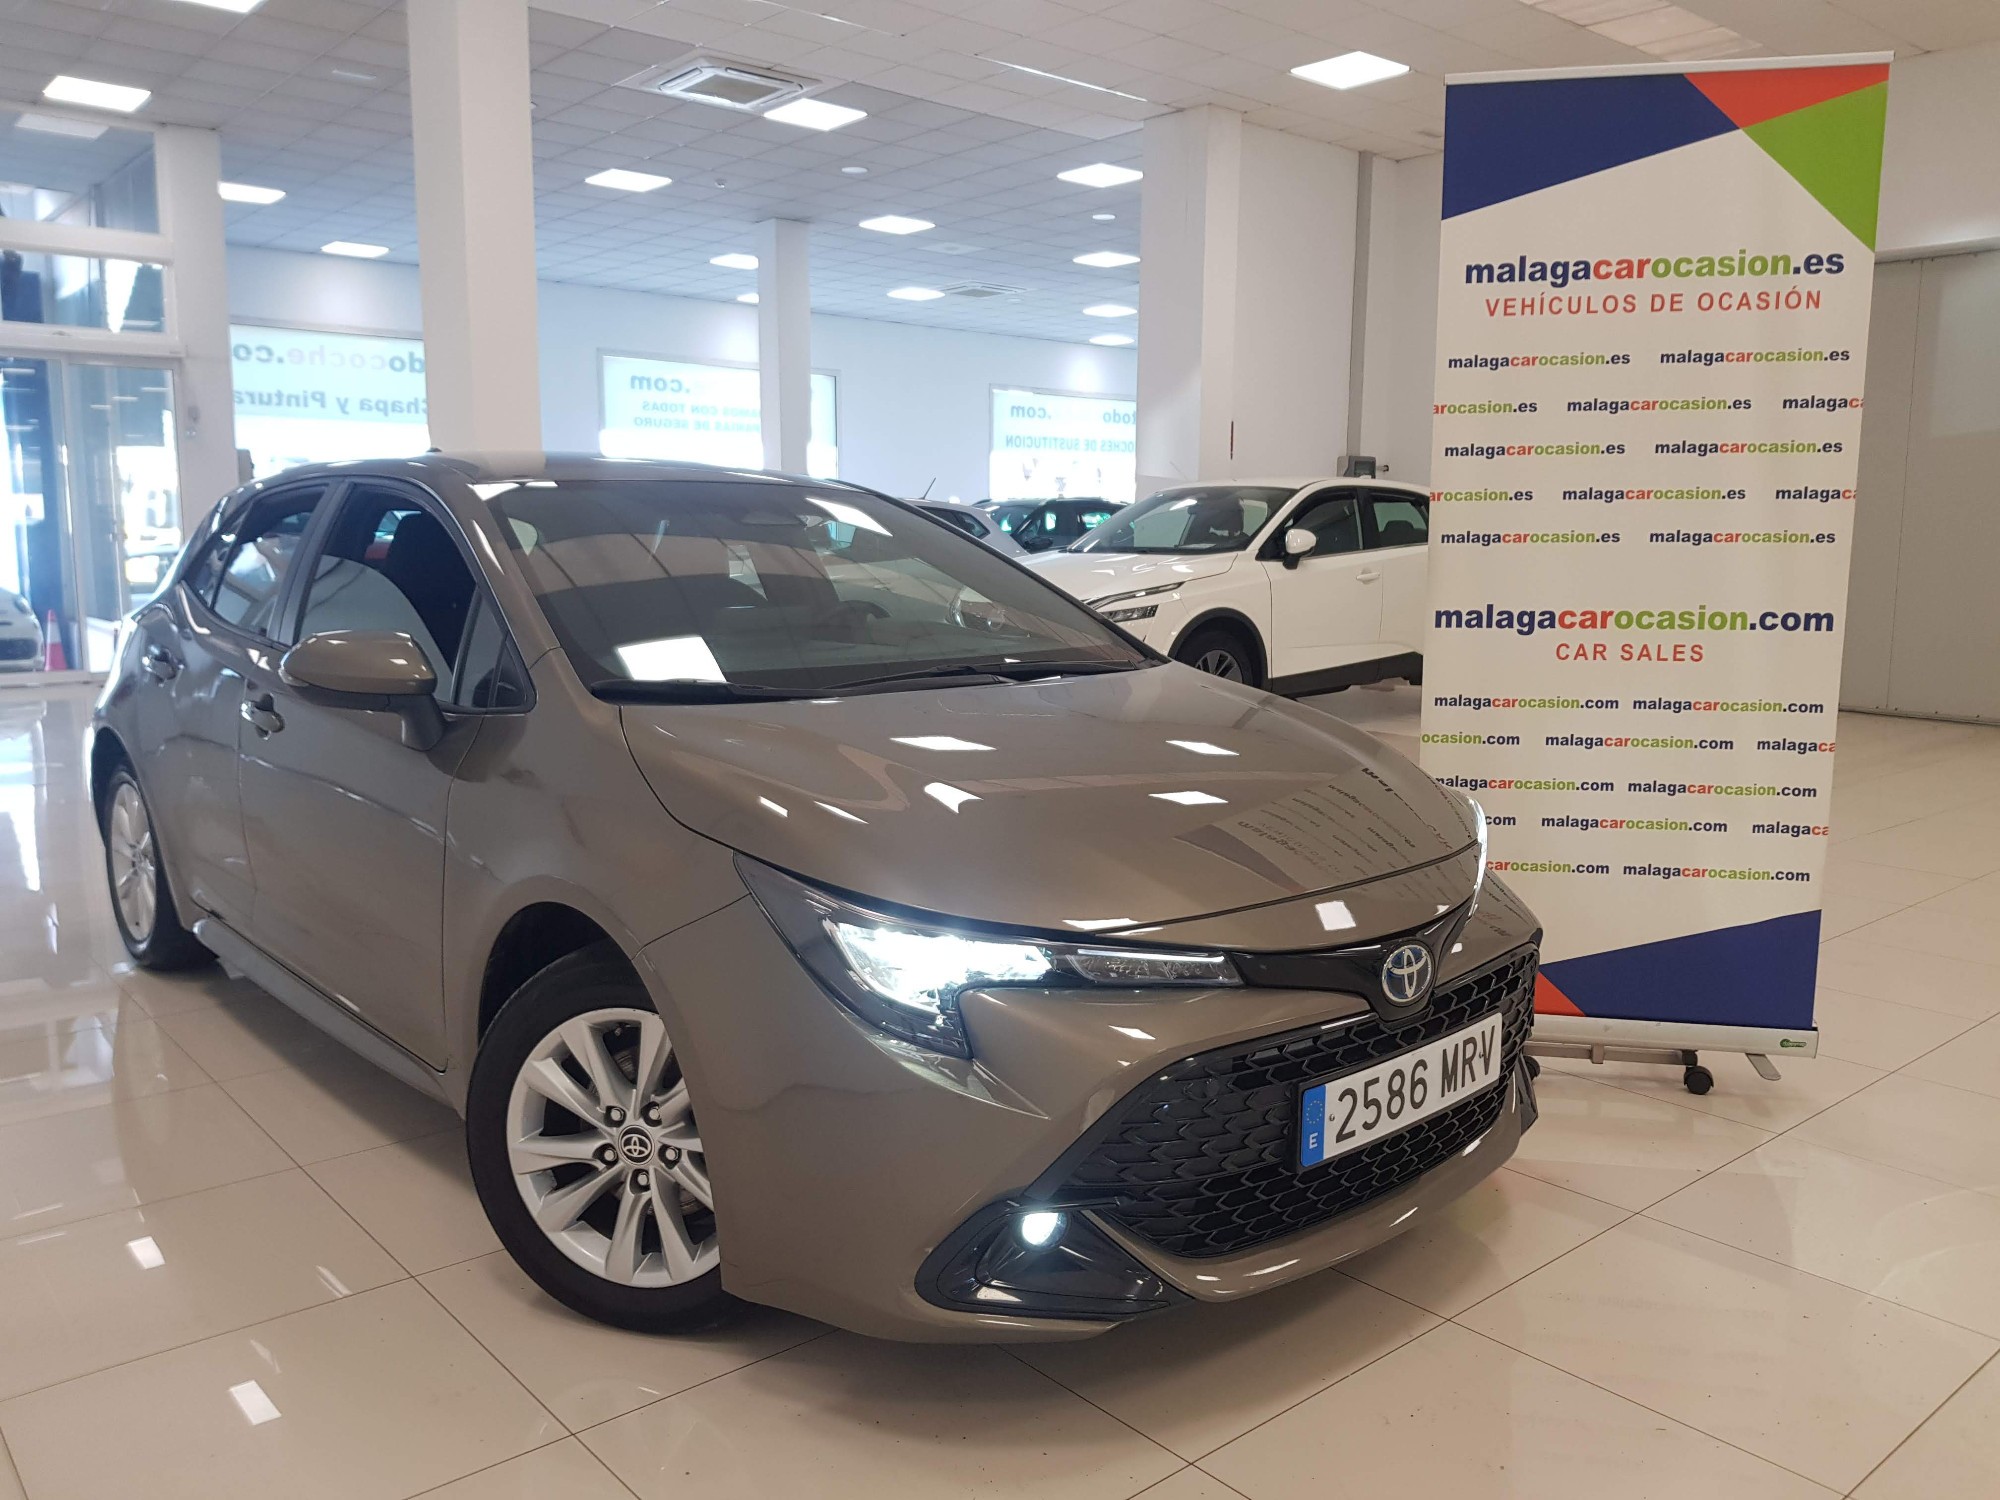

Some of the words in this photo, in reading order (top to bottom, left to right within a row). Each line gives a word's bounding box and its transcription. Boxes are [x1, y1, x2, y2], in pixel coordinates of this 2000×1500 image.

[1465, 249, 1845, 289] malagacarocasion.es
[1485, 291, 1637, 318] VEHÍCULOS
[1650, 293, 1684, 313] DE
[1697, 285, 1821, 312] OCASIÓN
[1448, 352, 1631, 371] malagacarocasion.es
[1660, 348, 1850, 366] malagacarocasion.es
[1567, 396, 1752, 415] malagacarocasion.es
[1444, 441, 1626, 460] malagacarocasion.es
[1655, 440, 1843, 457] malagacarocasion.es
[1562, 486, 1746, 504] malagacarocasion.es
[1441, 530, 1621, 547] malagacarocasion.es
[1649, 529, 1836, 547] malagacarocasion.es
[1434, 603, 1834, 636] malagacarocasion.com
[1555, 643, 1607, 661] CAR
[1620, 643, 1704, 663] SALES
[1434, 694, 1619, 711] malagacarocasion.com
[1632, 697, 1824, 714] malagacarocasion.com
[1545, 733, 1734, 751] malagacarocasion.com
[1628, 780, 1817, 798] malagacarocasion.com
[1541, 815, 1728, 833] malagacarocasion.com
[1623, 864, 1811, 882] malagacarocasion.com
[1335, 1058, 1428, 1143] 2586
[1440, 1025, 1496, 1098] MRV
[1309, 1133, 1319, 1149] E
